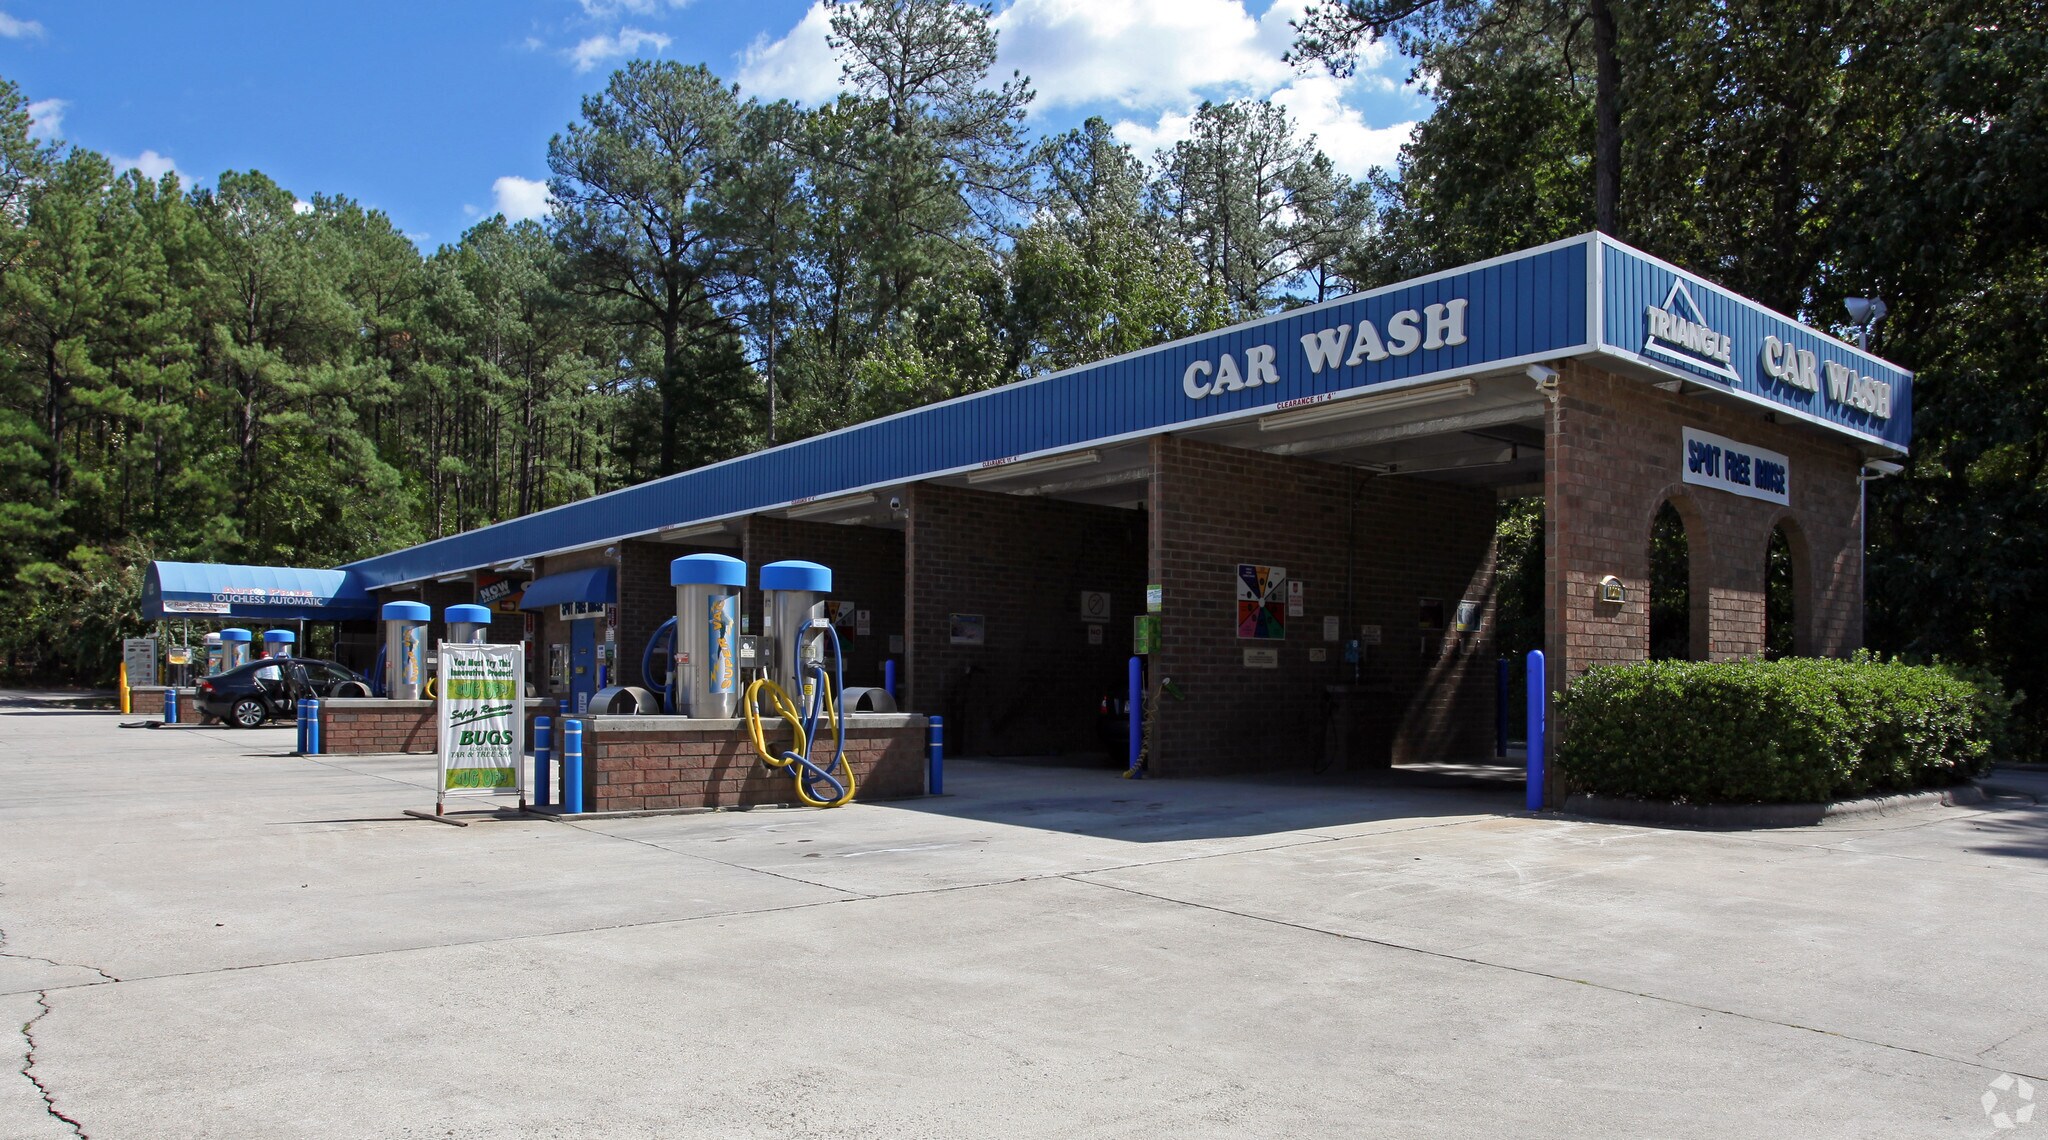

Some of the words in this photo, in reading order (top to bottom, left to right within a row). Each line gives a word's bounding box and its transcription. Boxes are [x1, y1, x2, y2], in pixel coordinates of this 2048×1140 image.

[1645, 305, 1731, 363] TRIANGLE
[1183, 344, 1281, 399] CAR
[1300, 298, 1468, 374] WASH
[1762, 335, 1819, 393] CAR
[1823, 360, 1892, 420] WASH
[1276, 396, 1315, 409] CLEARANCE
[1688, 439, 1721, 479] SPOT
[1724, 450, 1751, 487] FREE
[1754, 457, 1786, 496] RINSE
[480, 580, 510, 599] NOW
[212, 593, 266, 604] TOUCHLESS
[269, 595, 323, 606] AUTOMATIC
[450, 668, 485, 677] Innovative
[454, 658, 466, 667] You
[468, 658, 483, 667] Must
[486, 658, 496, 669] Try
[498, 658, 511, 668] This
[717, 637, 734, 690] SUPER
[450, 707, 478, 720] Safely
[459, 729, 513, 746] BUGS
